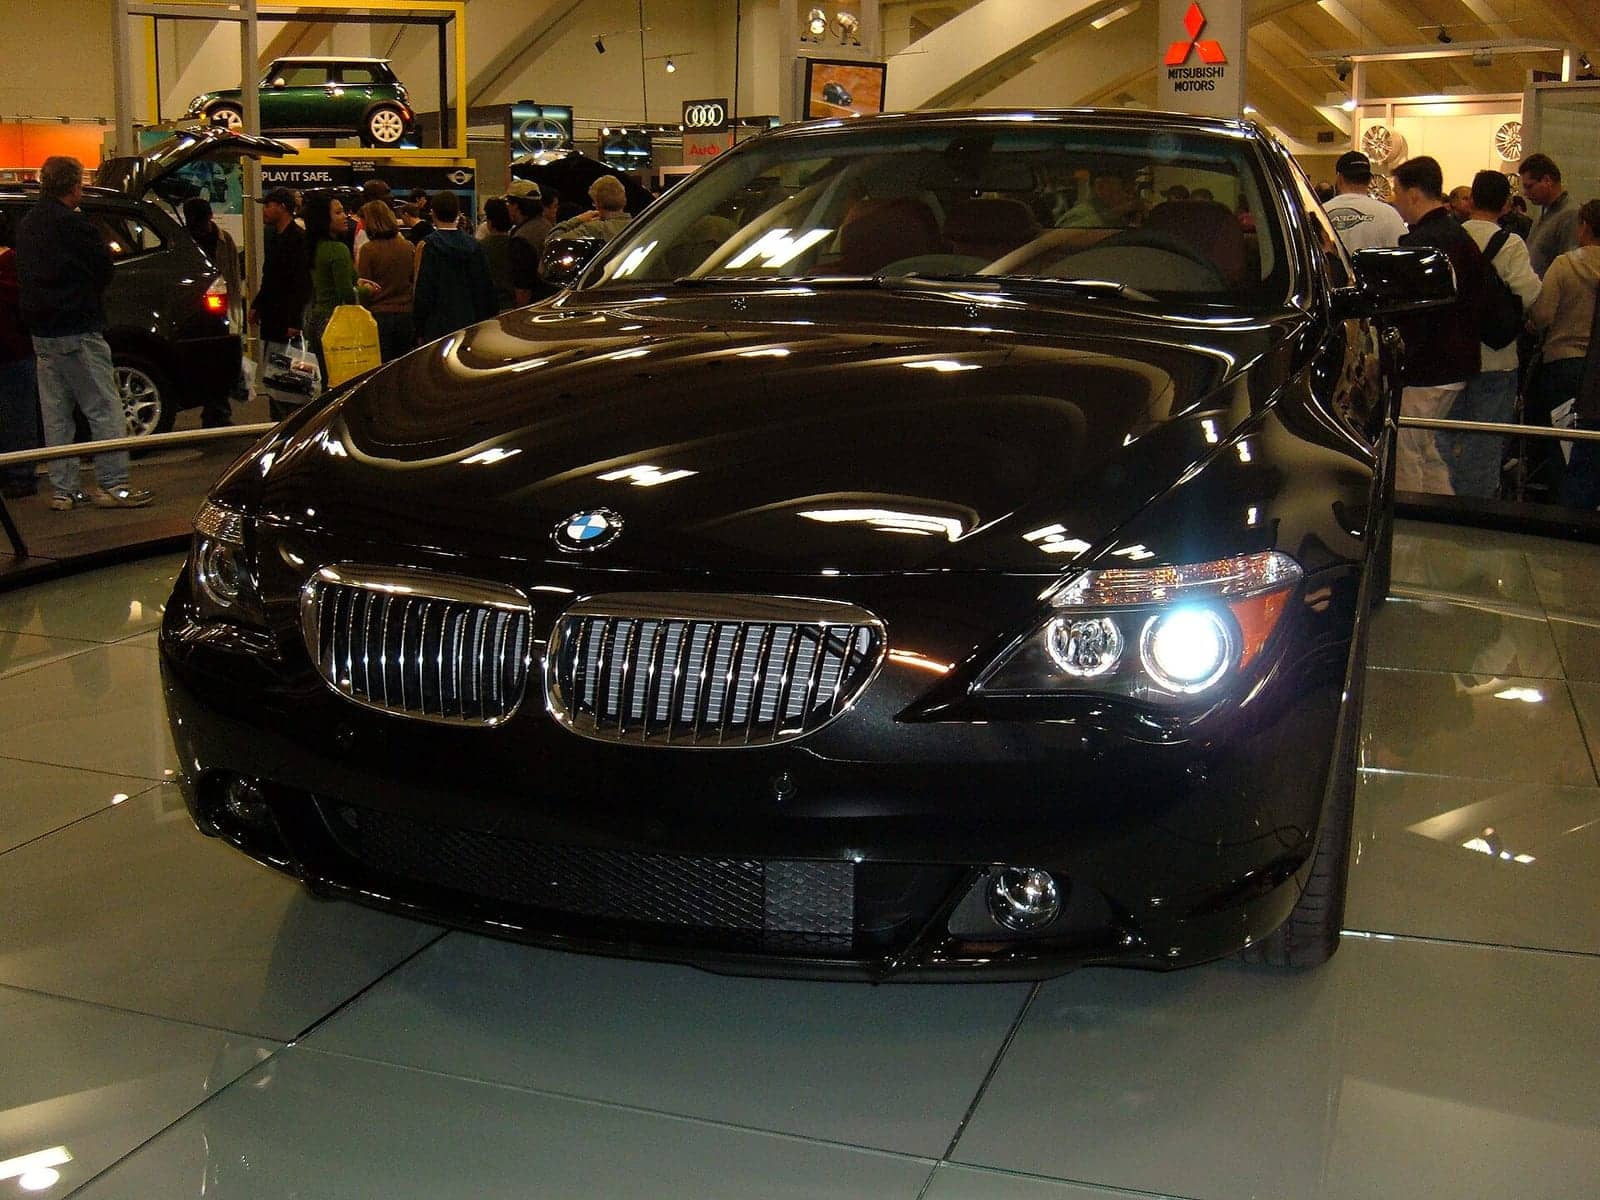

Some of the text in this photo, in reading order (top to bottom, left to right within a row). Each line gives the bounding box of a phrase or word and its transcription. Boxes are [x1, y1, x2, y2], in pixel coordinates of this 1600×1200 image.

[1168, 67, 1225, 79] MITSUBISHI
[1174, 80, 1216, 92] MOTORS
[261, 171, 333, 182] PLAY IT SAFE.
